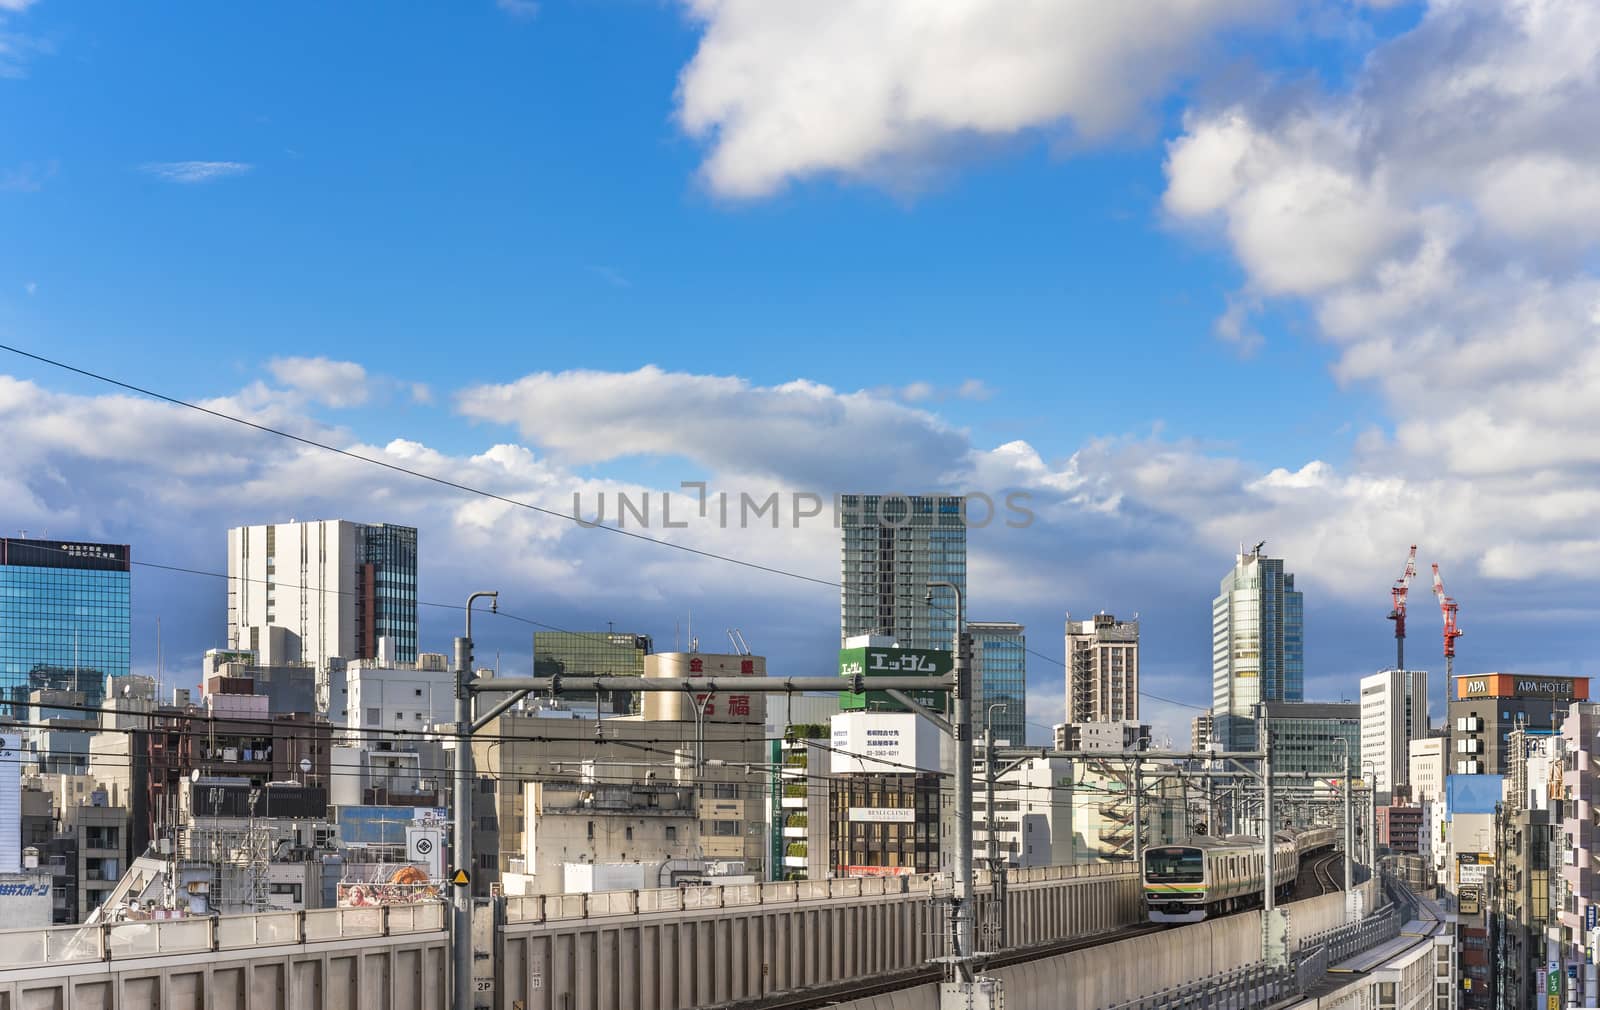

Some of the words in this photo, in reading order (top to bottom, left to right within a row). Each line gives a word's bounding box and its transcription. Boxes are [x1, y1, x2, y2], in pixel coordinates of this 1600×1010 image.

[841, 661, 863, 675] エッサム
[869, 653, 936, 672] エッサム
[1467, 681, 1486, 693] APA
[1518, 680, 1538, 692] APA
[1539, 682, 1573, 693] HOTEL
[477, 982, 491, 991] 2P
